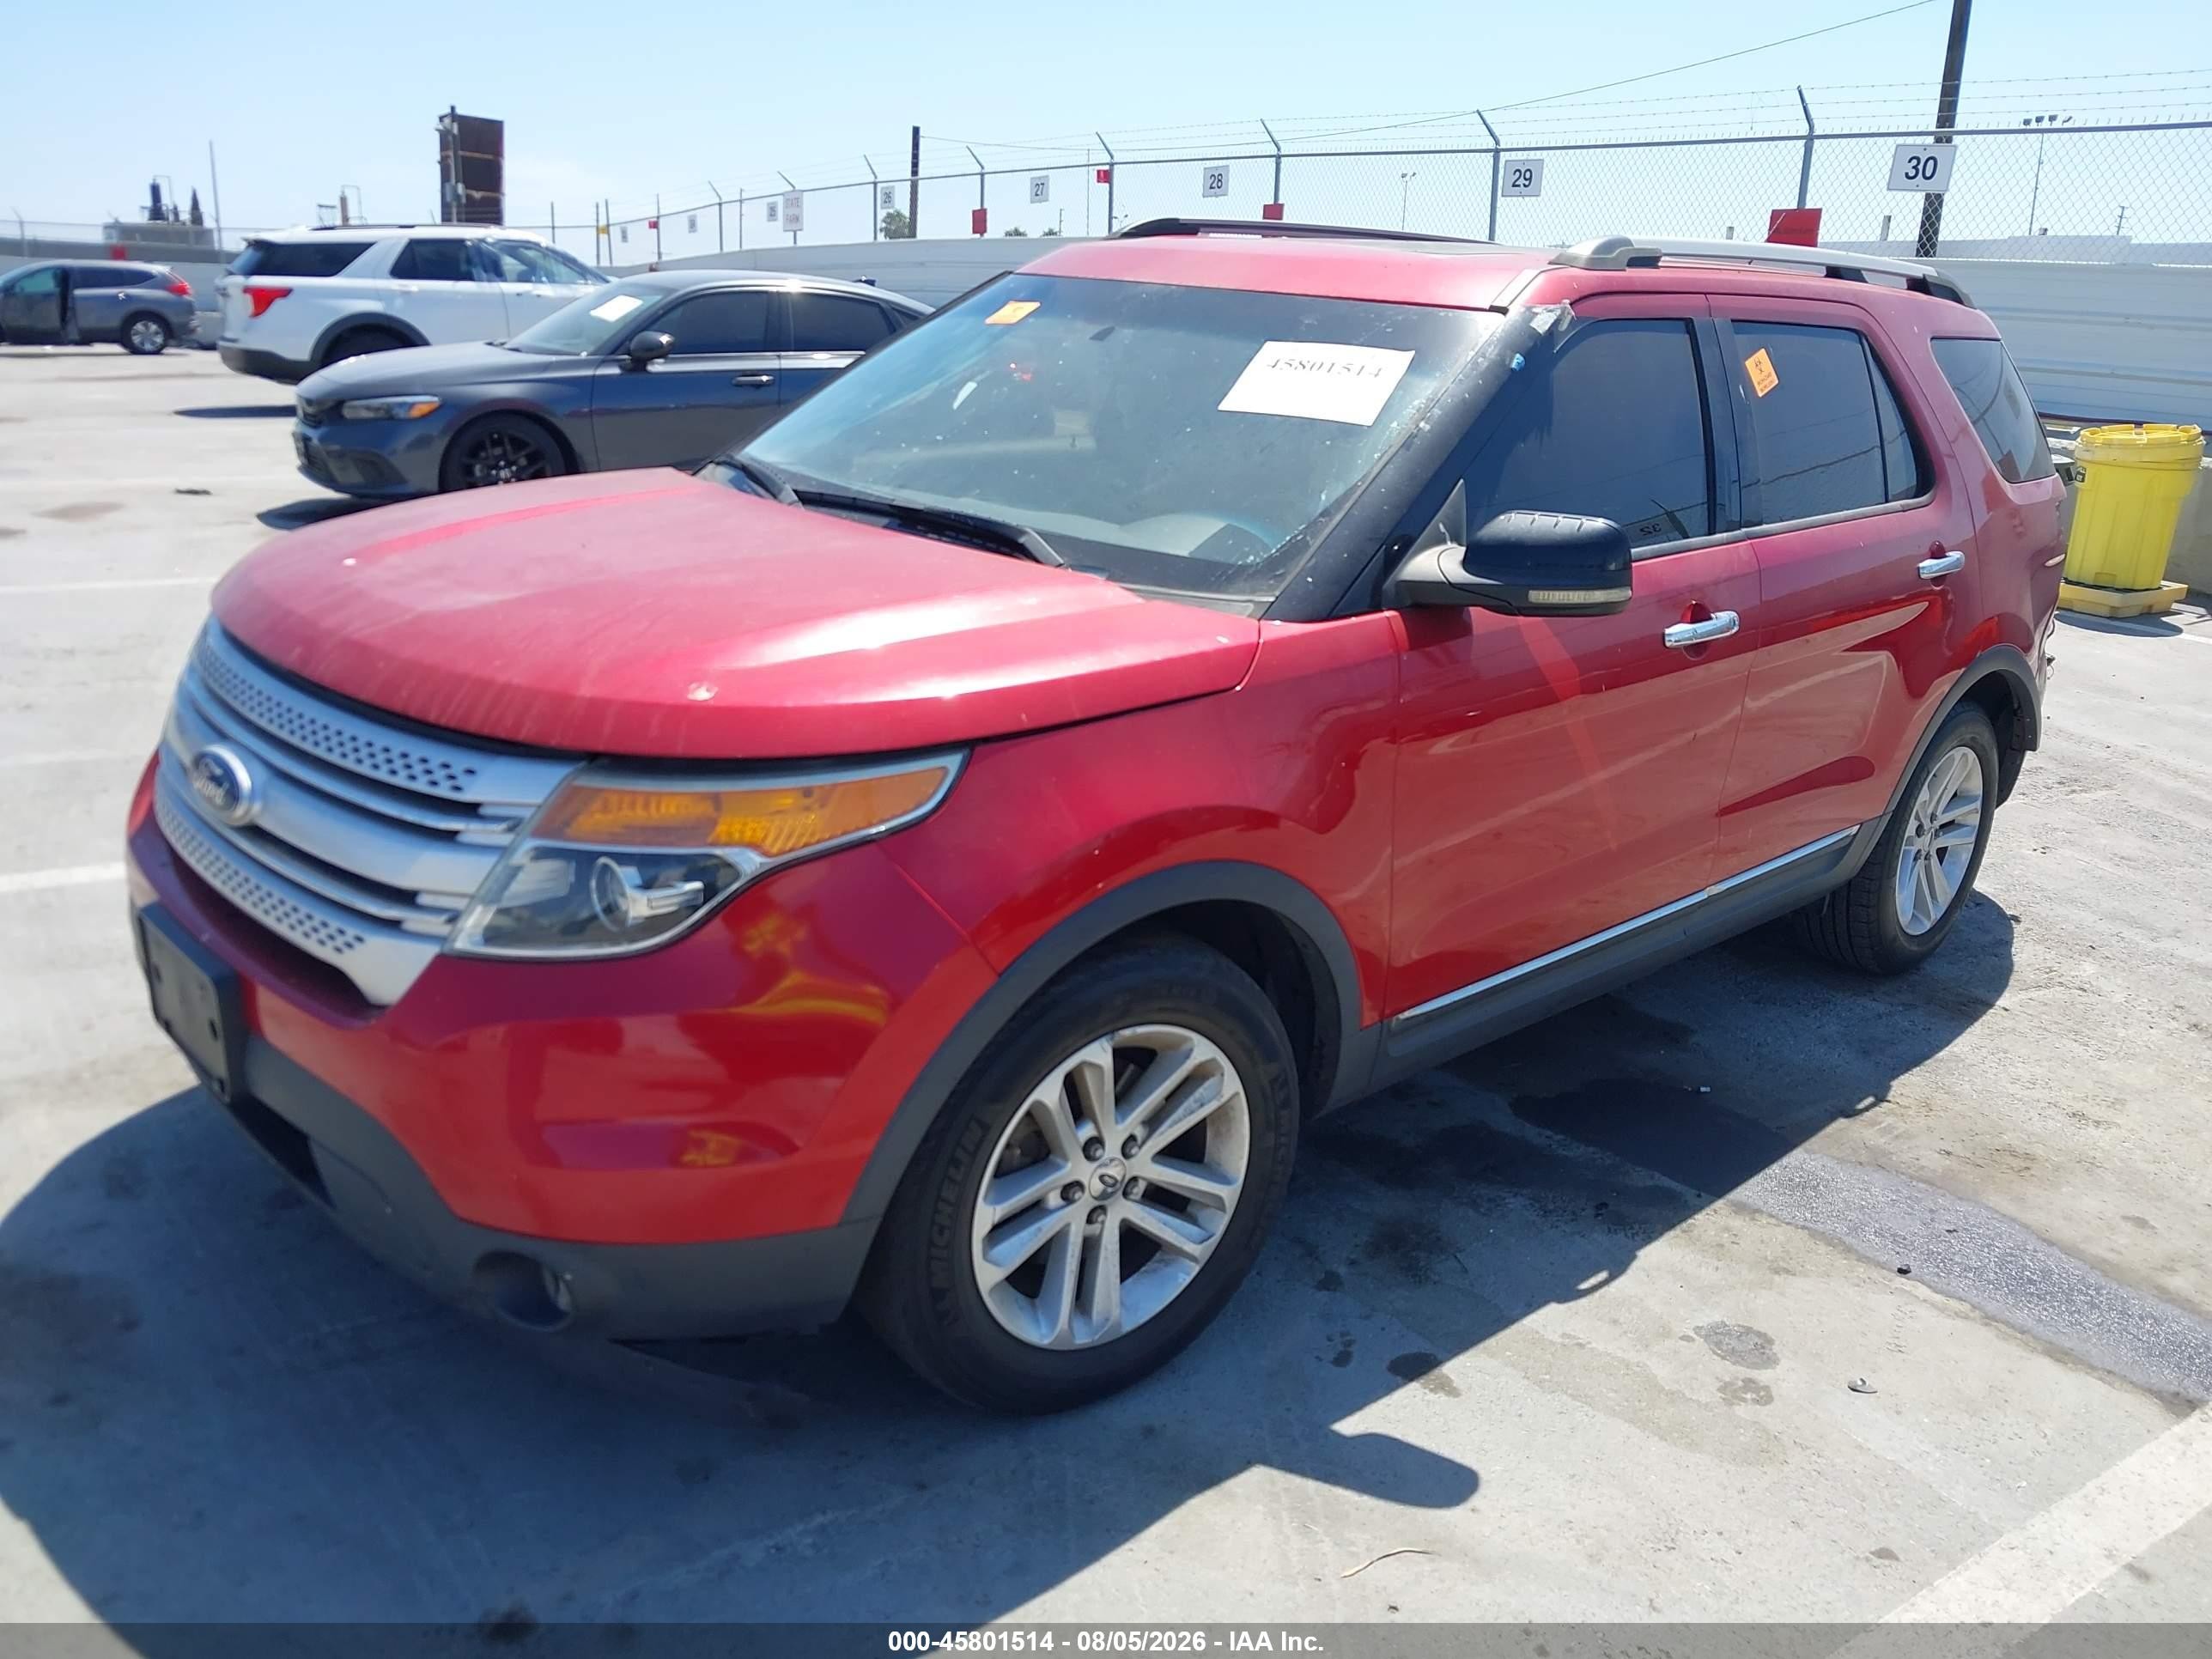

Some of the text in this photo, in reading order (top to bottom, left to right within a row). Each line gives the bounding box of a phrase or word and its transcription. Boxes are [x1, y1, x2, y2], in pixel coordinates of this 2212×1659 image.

[1904, 155, 1938, 180] 30
[1209, 173, 1223, 190] 28
[1511, 168, 1533, 188] 29
[883, 191, 892, 204] 26
[1035, 182, 1045, 197] 27
[785, 197, 800, 209] STATE
[1267, 357, 1382, 378] 45801514
[192, 757, 230, 805] Ford
[928, 1113, 988, 1291] MICHELIN
